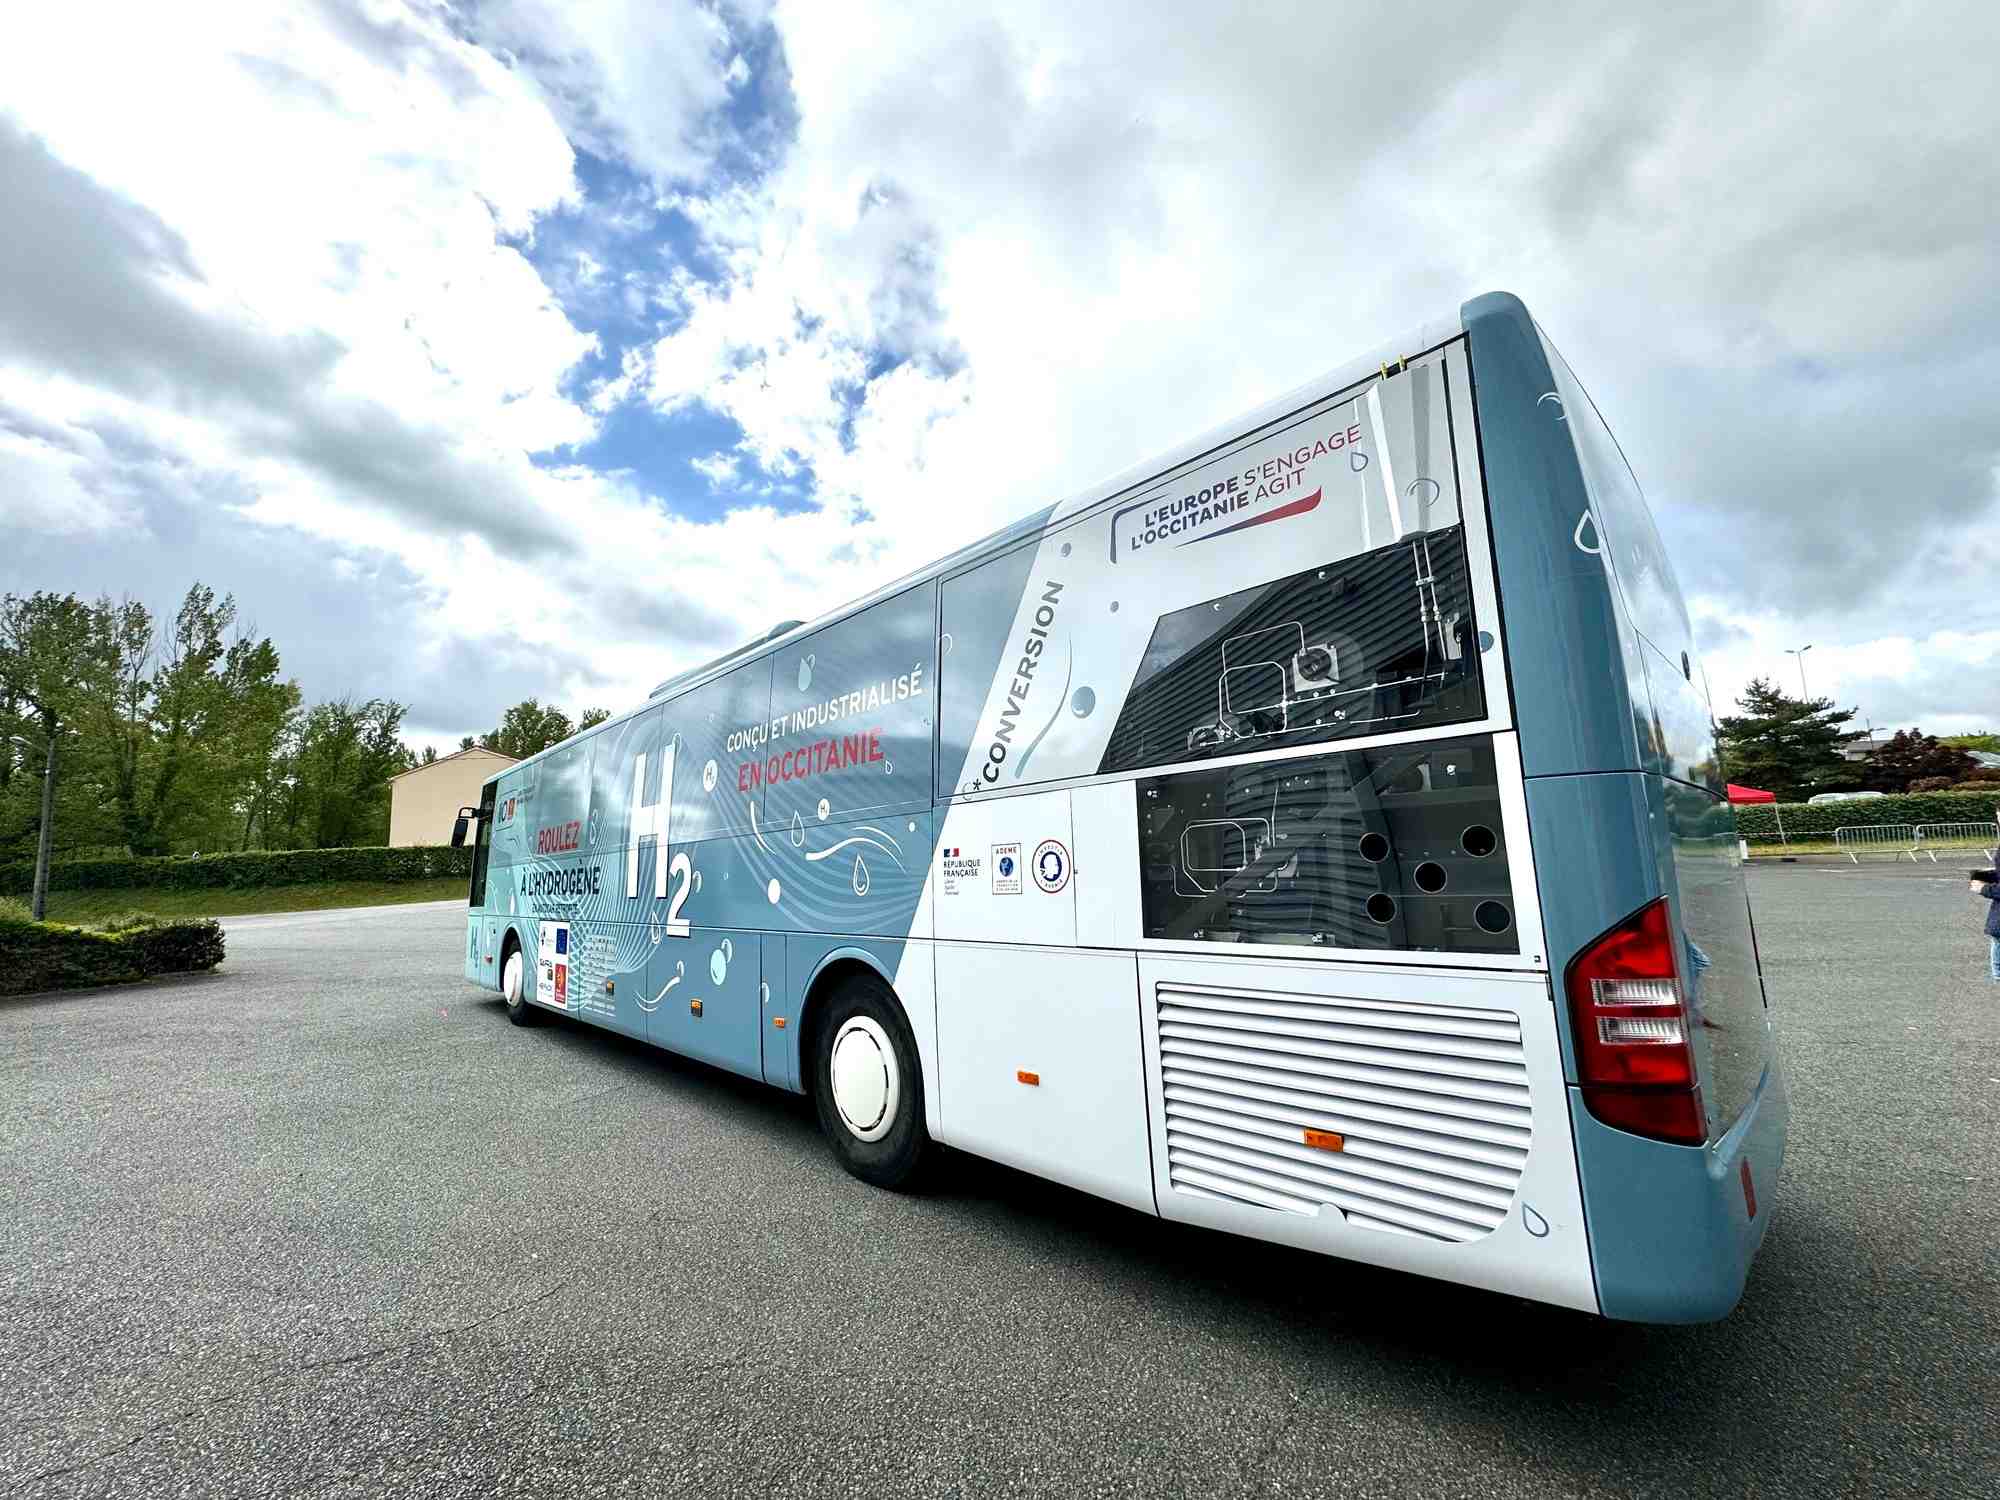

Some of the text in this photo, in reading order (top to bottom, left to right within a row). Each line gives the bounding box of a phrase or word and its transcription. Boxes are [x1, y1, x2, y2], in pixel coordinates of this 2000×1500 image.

[1144, 423, 1362, 528] L'EUROPE S'ENGAGE
[1131, 468, 1306, 551] L'OCCITANIE AGIT
[727, 663, 923, 753] CONÇU ET INDUSTRIALISÉ
[738, 727, 884, 792] EN OCCITANIE
[538, 821, 581, 854] ROULEZ
[528, 858, 600, 896] L'HYDROGÈNE
[943, 859, 981, 868] RÉPUBLIQUE
[943, 869, 978, 878] FRANÇAISE
